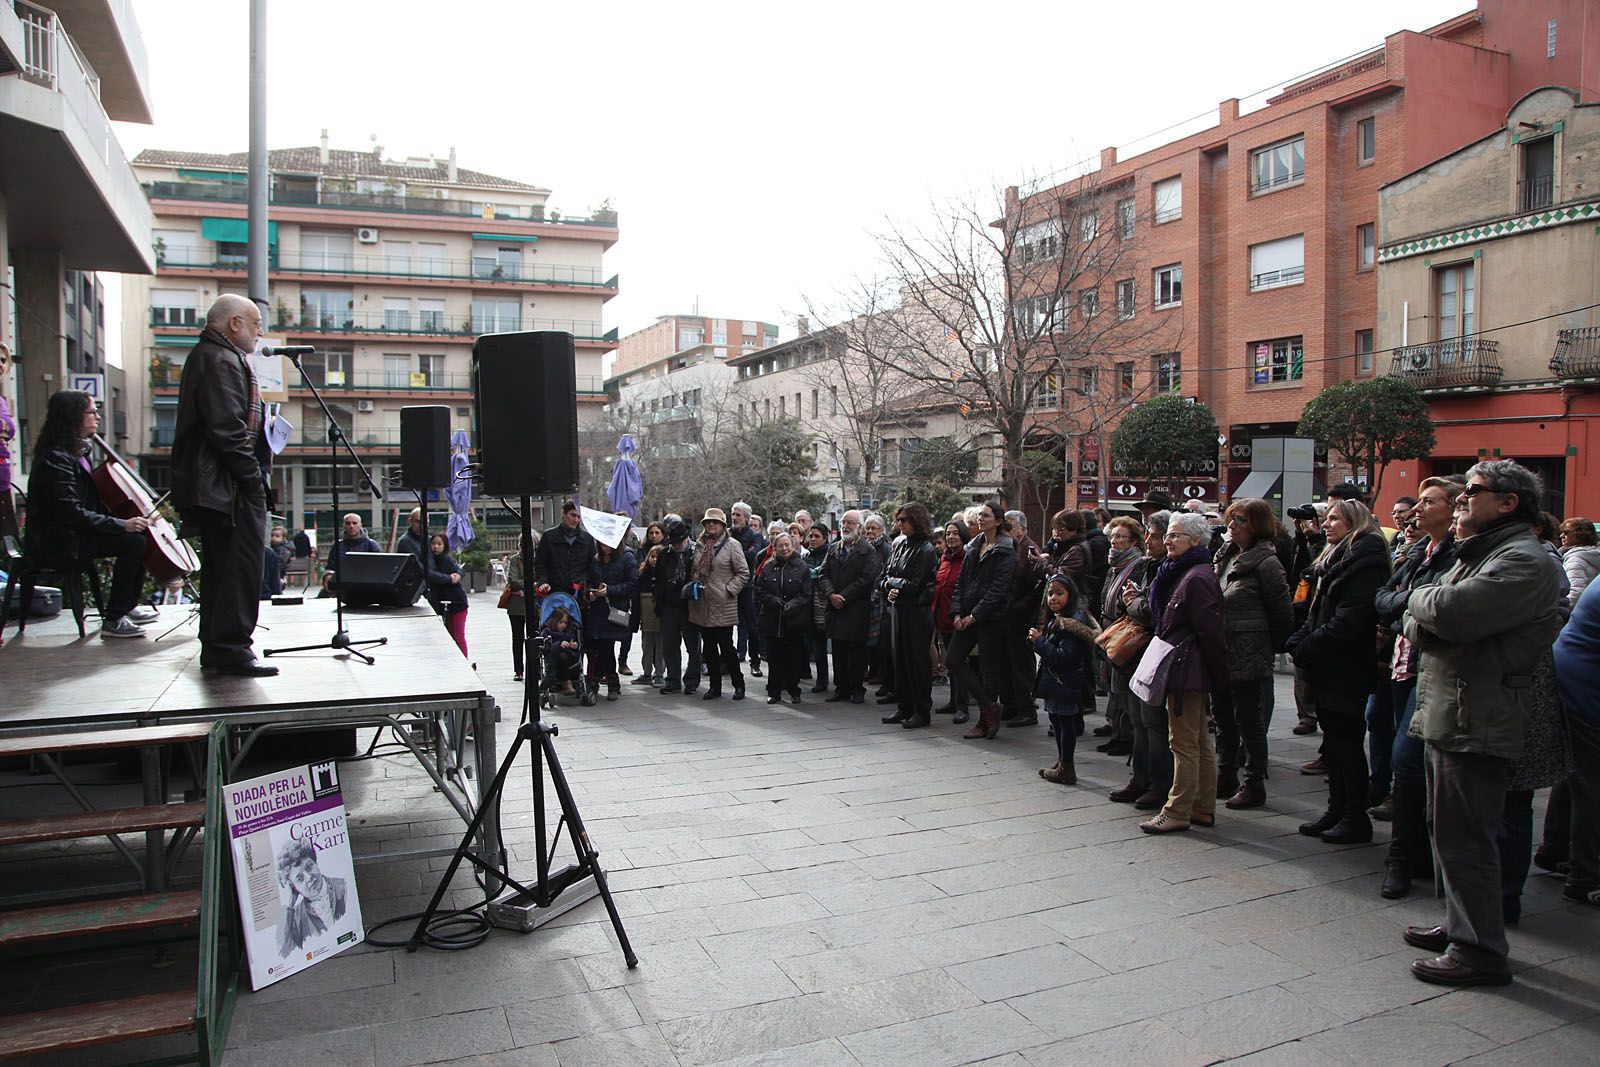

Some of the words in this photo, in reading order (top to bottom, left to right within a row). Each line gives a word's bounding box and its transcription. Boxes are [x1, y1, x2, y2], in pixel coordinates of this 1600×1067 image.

[232, 785, 267, 805] DIADA
[269, 779, 290, 795] PER
[292, 774, 306, 788] LA
[235, 790, 308, 821] NOVIOLÈNCIA
[290, 815, 343, 841] Carme
[309, 831, 346, 851] Karr
